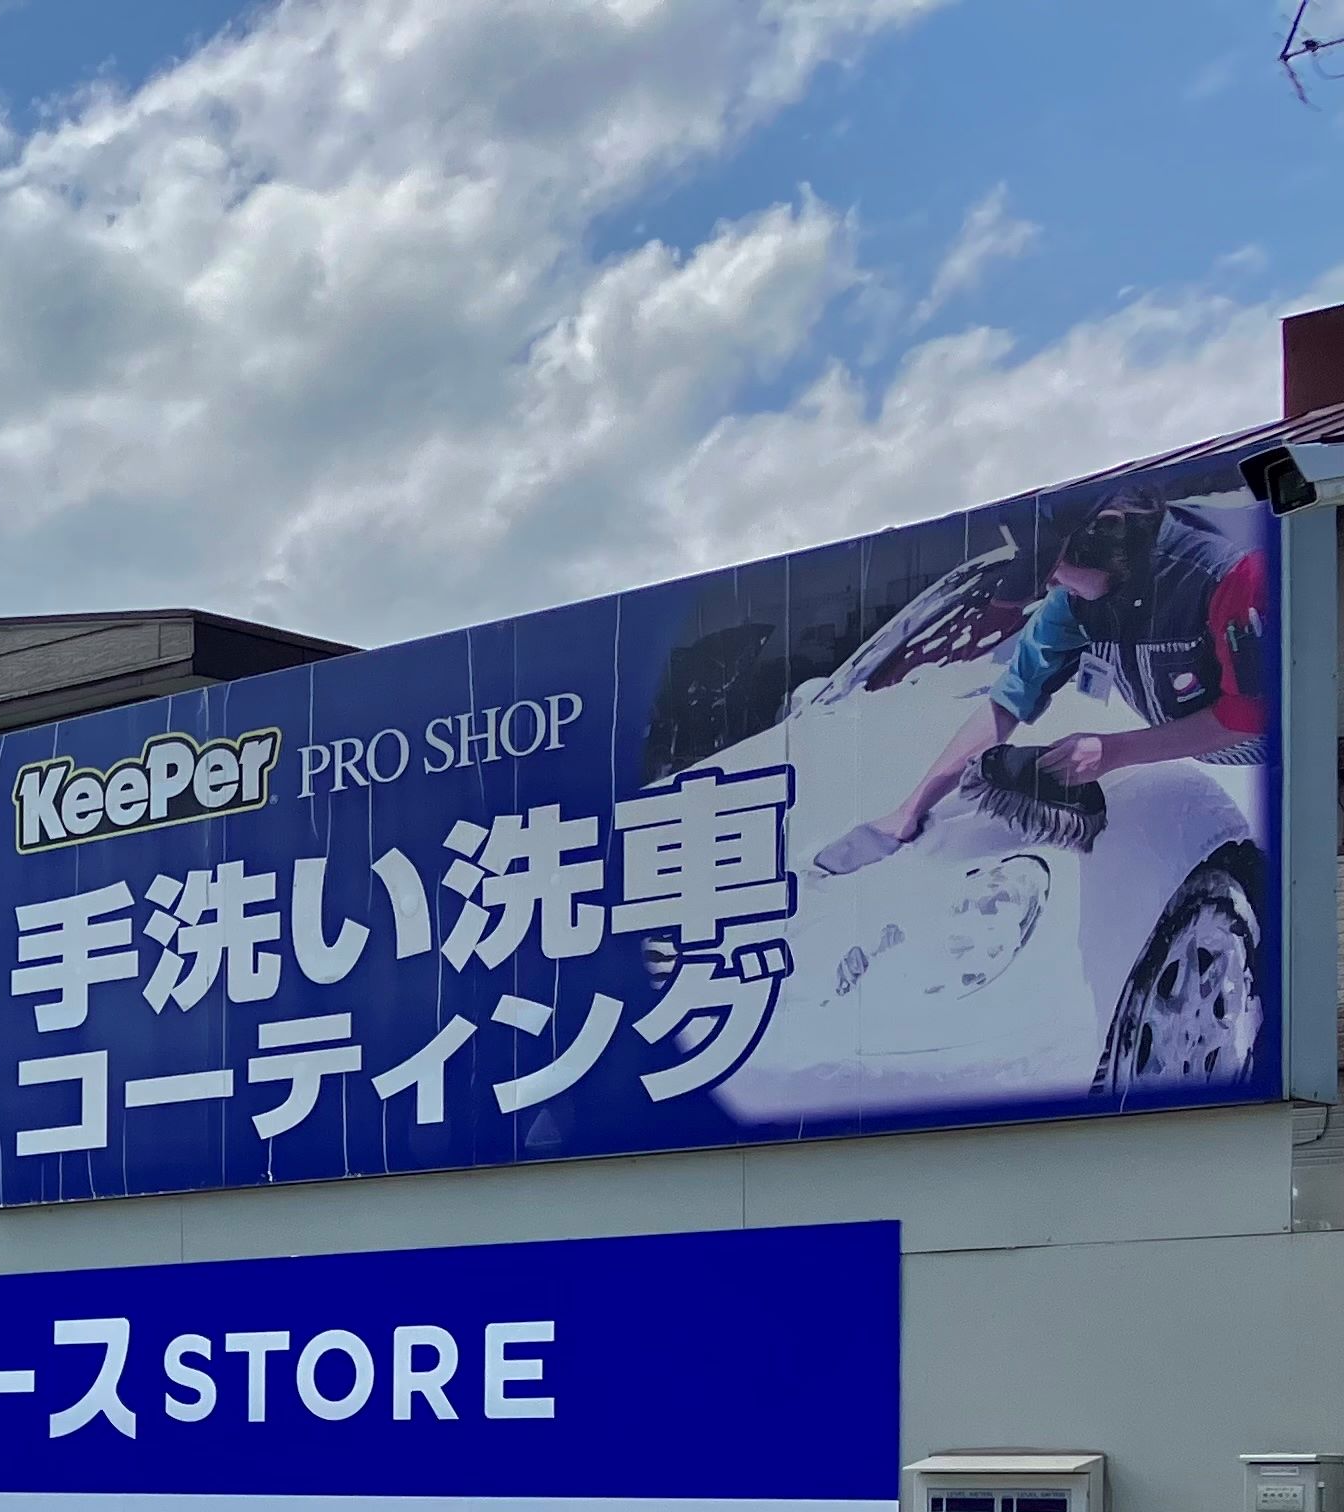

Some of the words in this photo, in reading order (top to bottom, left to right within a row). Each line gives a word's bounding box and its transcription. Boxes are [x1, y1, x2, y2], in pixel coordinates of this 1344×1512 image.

[18, 732, 279, 848] KeePer
[297, 728, 410, 799] PRO
[423, 693, 583, 775] SHOP
[11, 774, 790, 1033] 手洗い洗車
[15, 942, 788, 1158] コーティング
